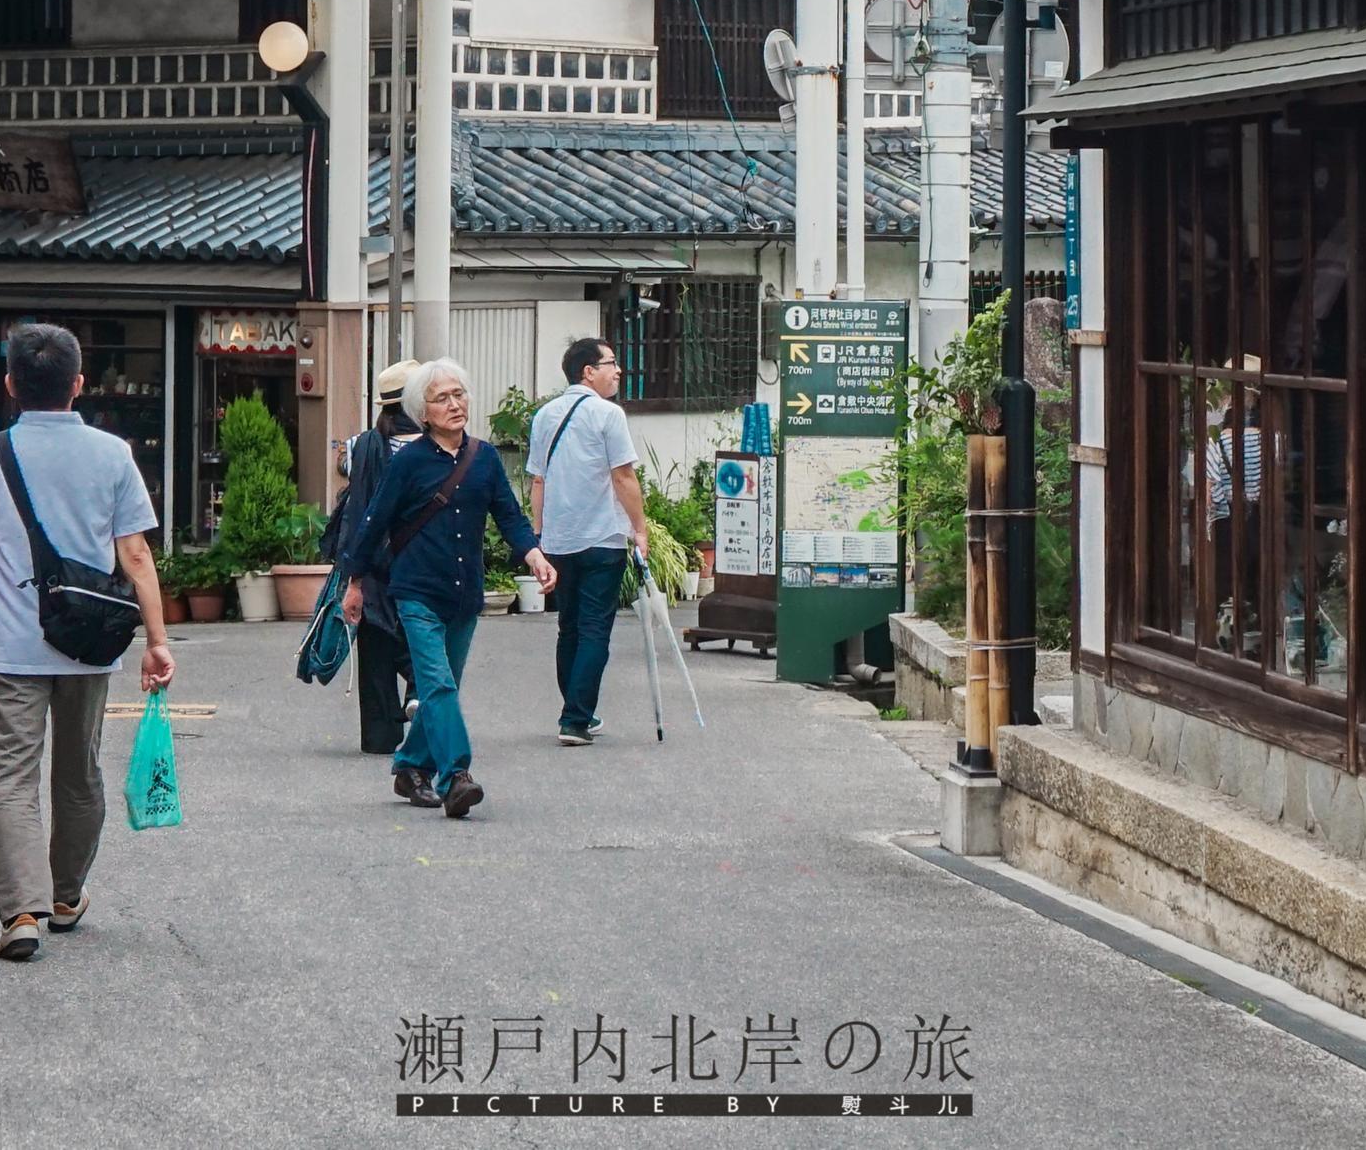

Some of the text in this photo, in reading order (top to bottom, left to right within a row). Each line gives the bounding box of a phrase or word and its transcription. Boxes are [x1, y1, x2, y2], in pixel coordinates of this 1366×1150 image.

[837, 345, 894, 357] JR倉敷駅
[837, 356, 847, 364] JR
[848, 356, 880, 364] Kurashiki
[788, 366, 813, 375] 700m
[787, 416, 812, 425] 700m
